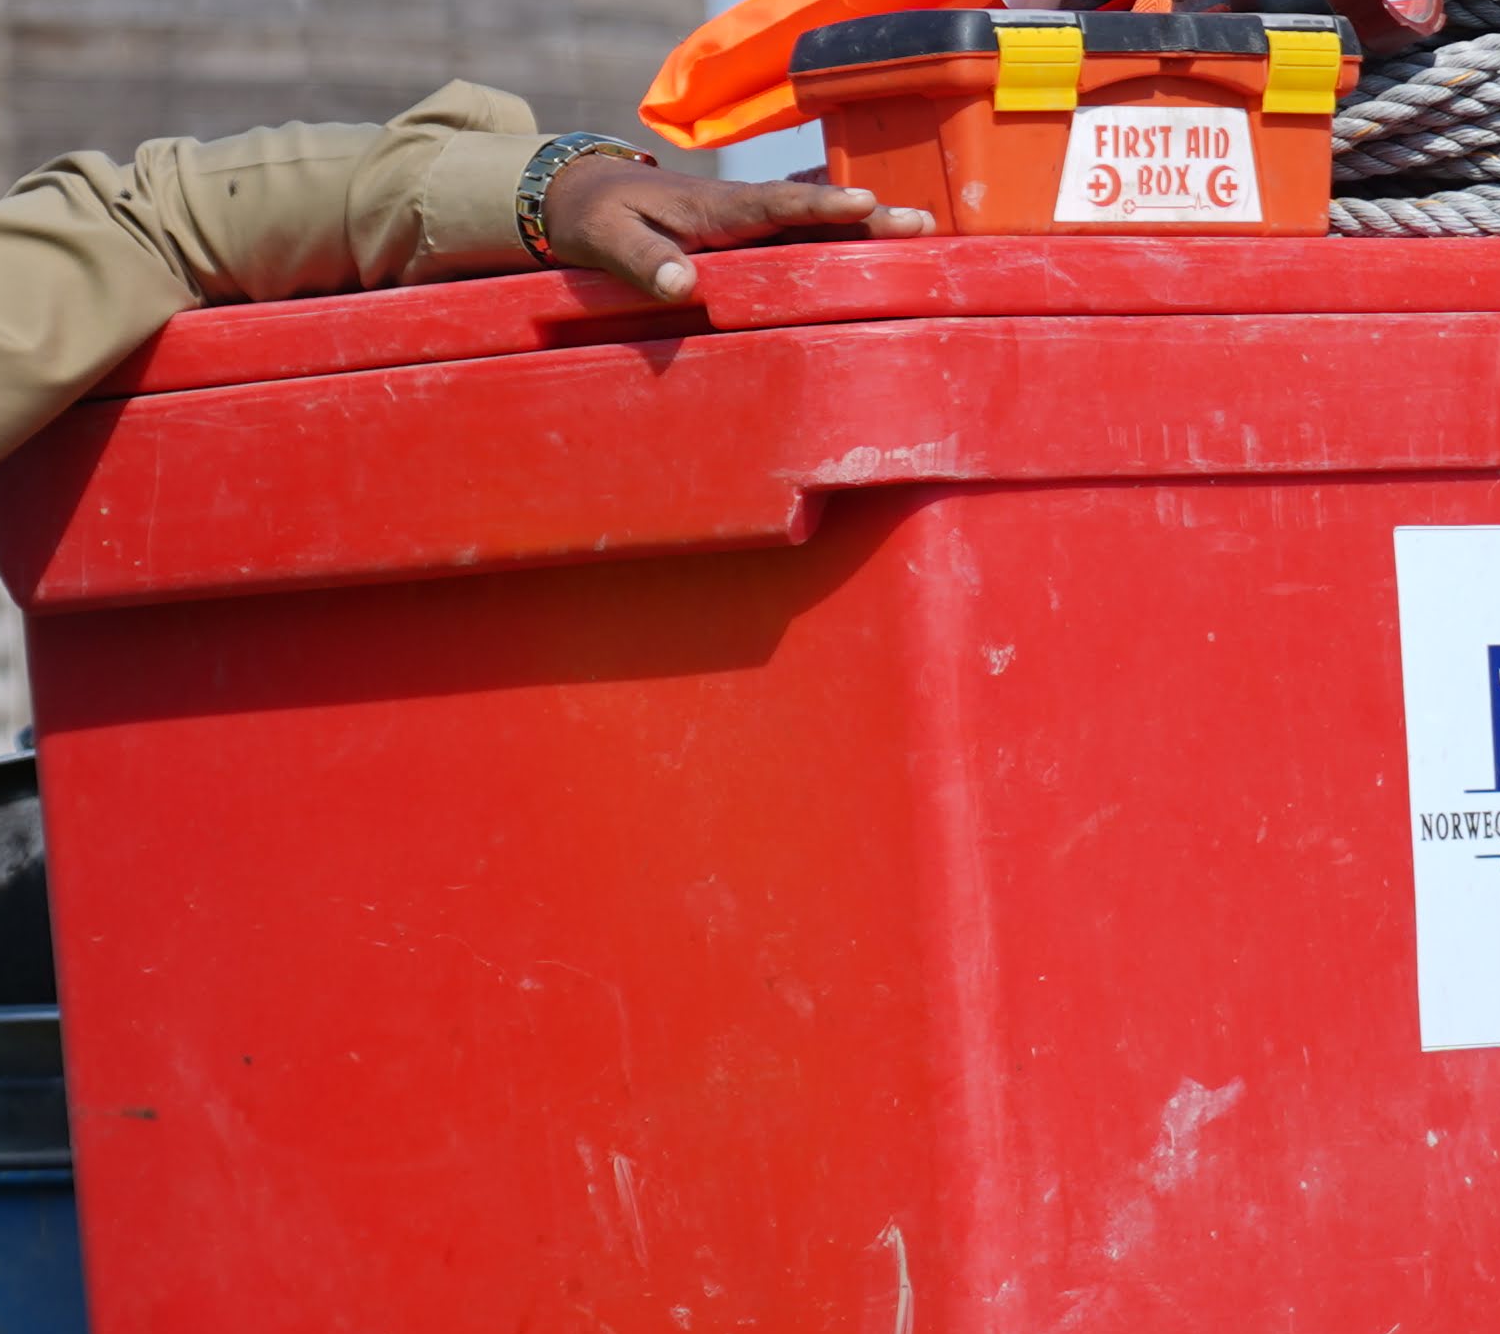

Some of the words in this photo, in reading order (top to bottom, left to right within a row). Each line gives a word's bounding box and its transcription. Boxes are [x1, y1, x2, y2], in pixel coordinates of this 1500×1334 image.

[1094, 124, 1173, 159] FIRST
[1186, 125, 1231, 159] AID
[1137, 164, 1191, 196] BOX
